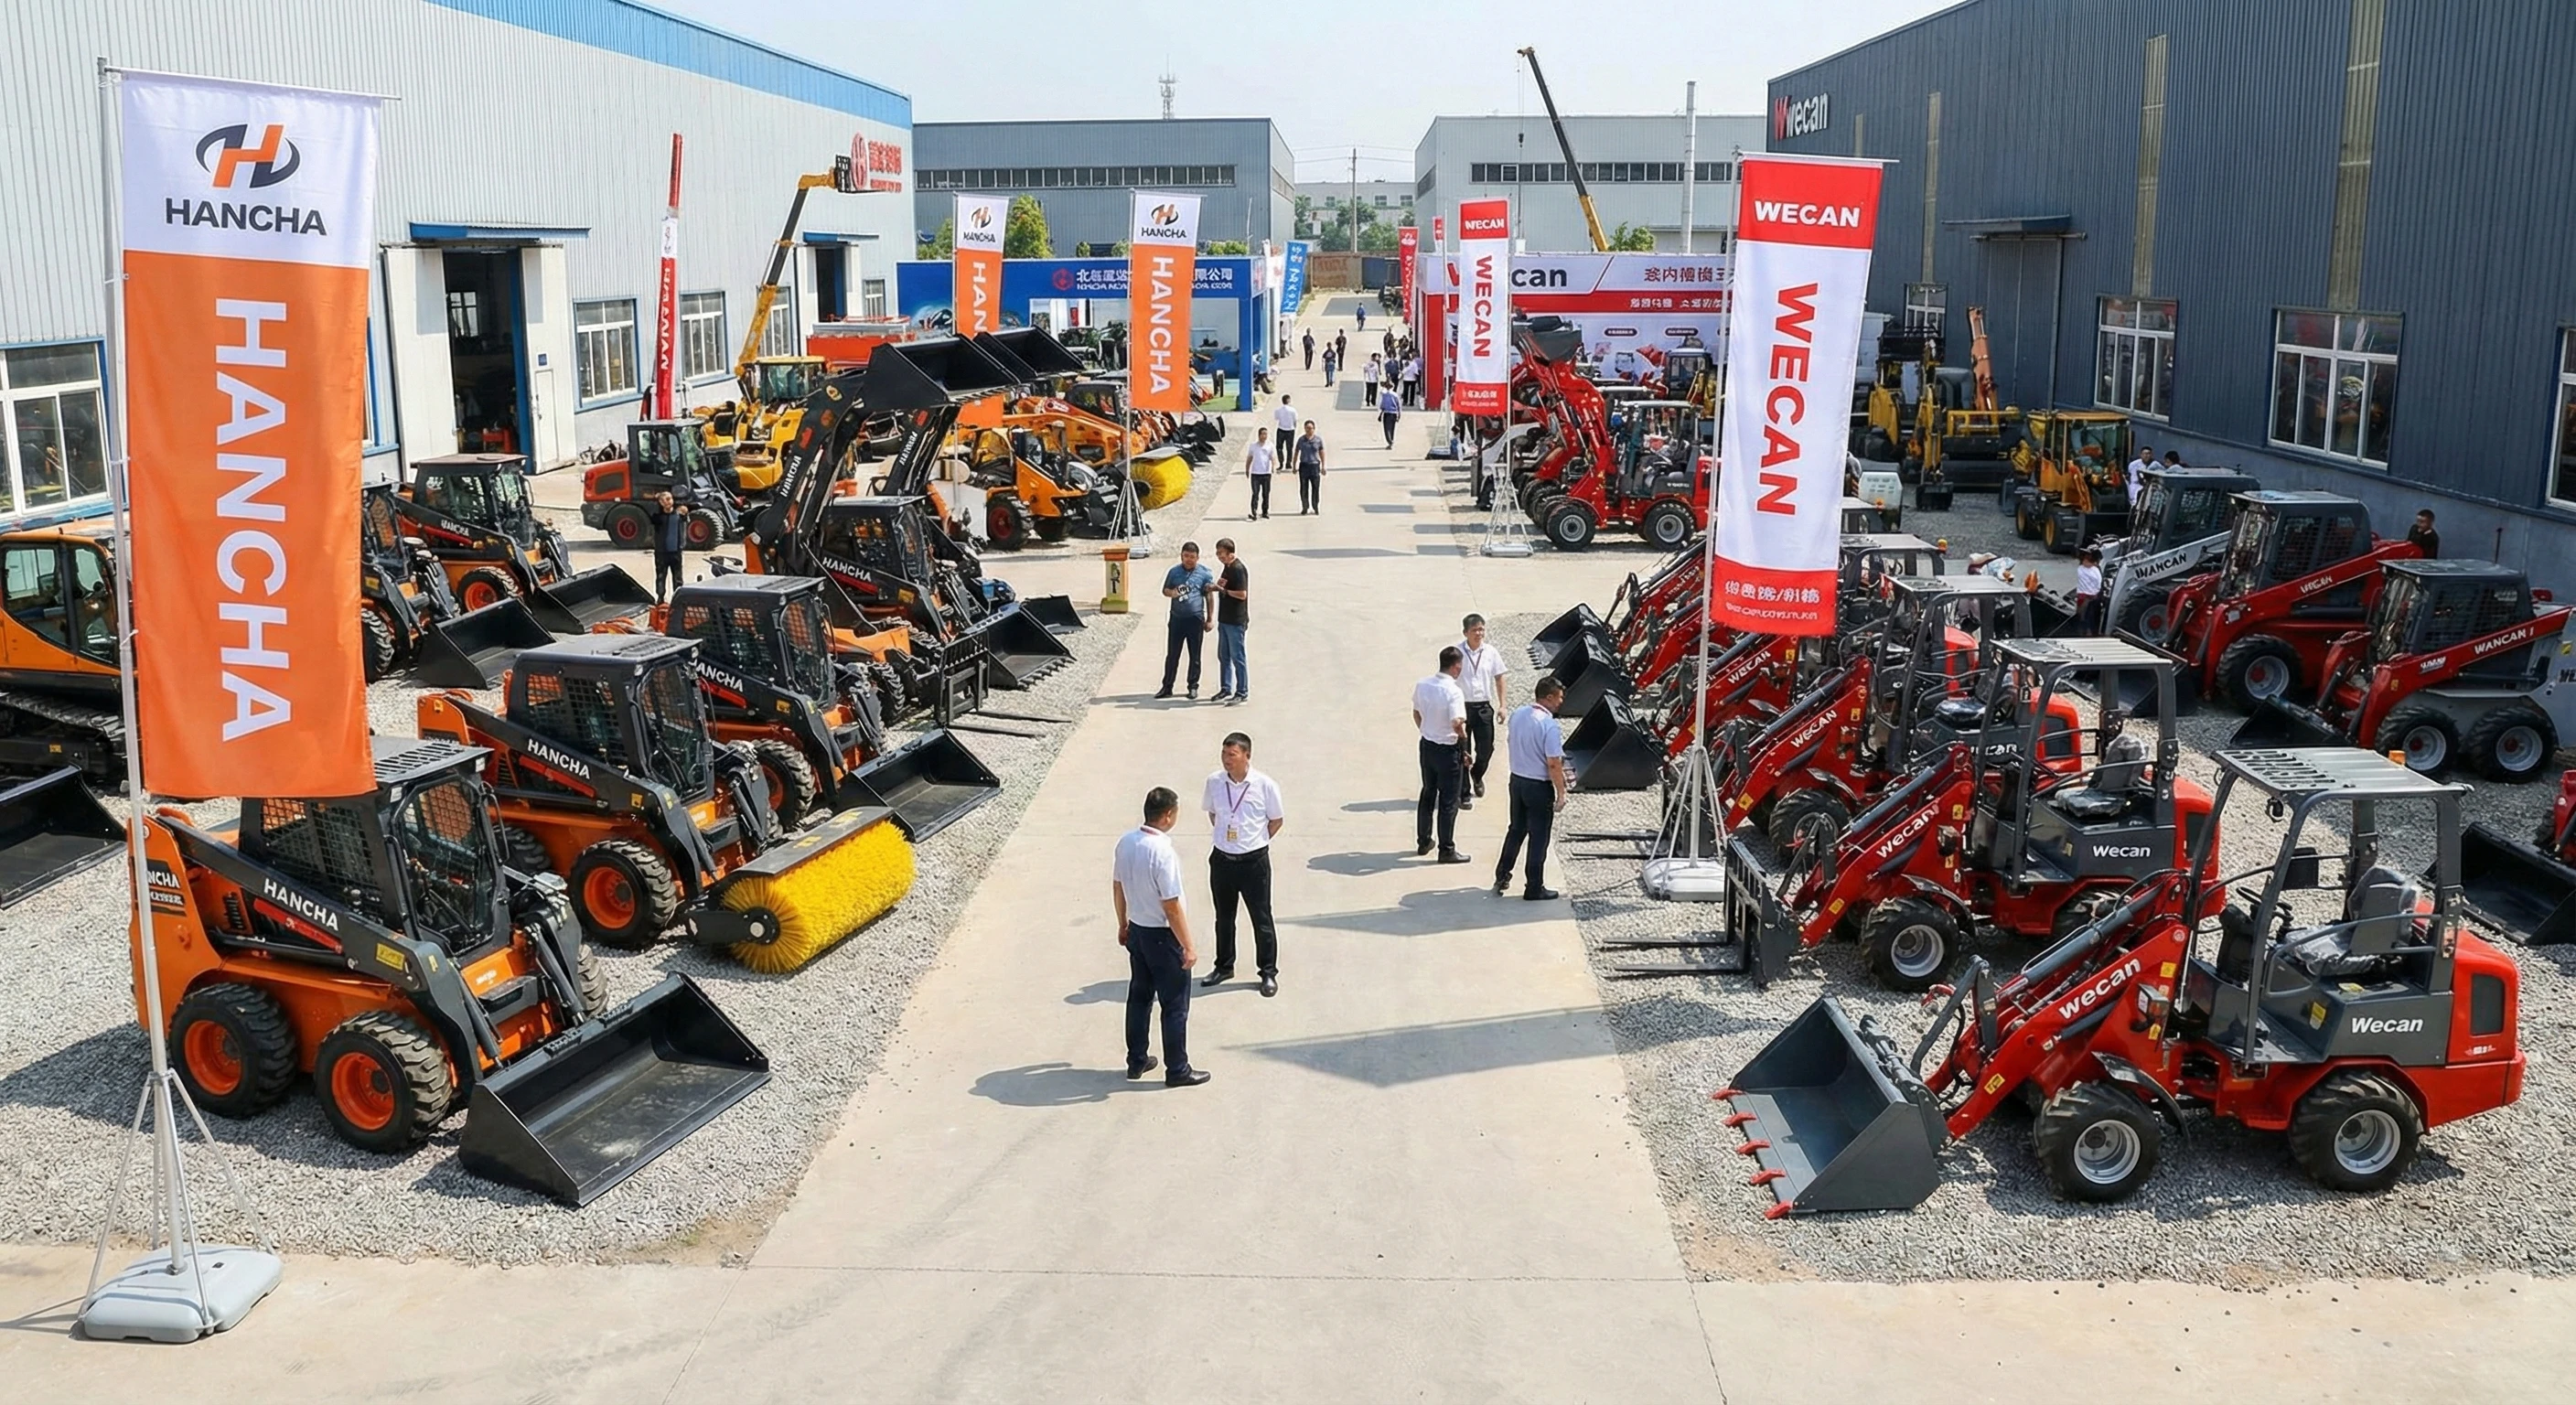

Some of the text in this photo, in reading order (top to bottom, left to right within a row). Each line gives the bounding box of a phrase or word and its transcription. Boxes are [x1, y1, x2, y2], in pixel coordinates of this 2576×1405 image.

[166, 198, 327, 236] HANCHA
[1755, 200, 1861, 228] WECAN
[1142, 228, 1186, 238] HANCHA
[1150, 256, 1174, 393] HANCHA
[1474, 255, 1492, 357] WECAN
[1756, 283, 1818, 515] WECAN
[216, 298, 291, 742] HANCHA
[822, 557, 872, 582] HANCHA
[2474, 628, 2526, 654] WANCAN
[1727, 650, 1771, 683] WECAN
[1790, 710, 1837, 747] WECAN
[528, 738, 590, 779] HANCHA
[2093, 845, 2151, 858] Wecan
[146, 870, 180, 888] NCHA
[264, 878, 338, 931] HANCHA
[2059, 959, 2141, 1019] wecan
[2351, 1017, 2424, 1034] Wecan
